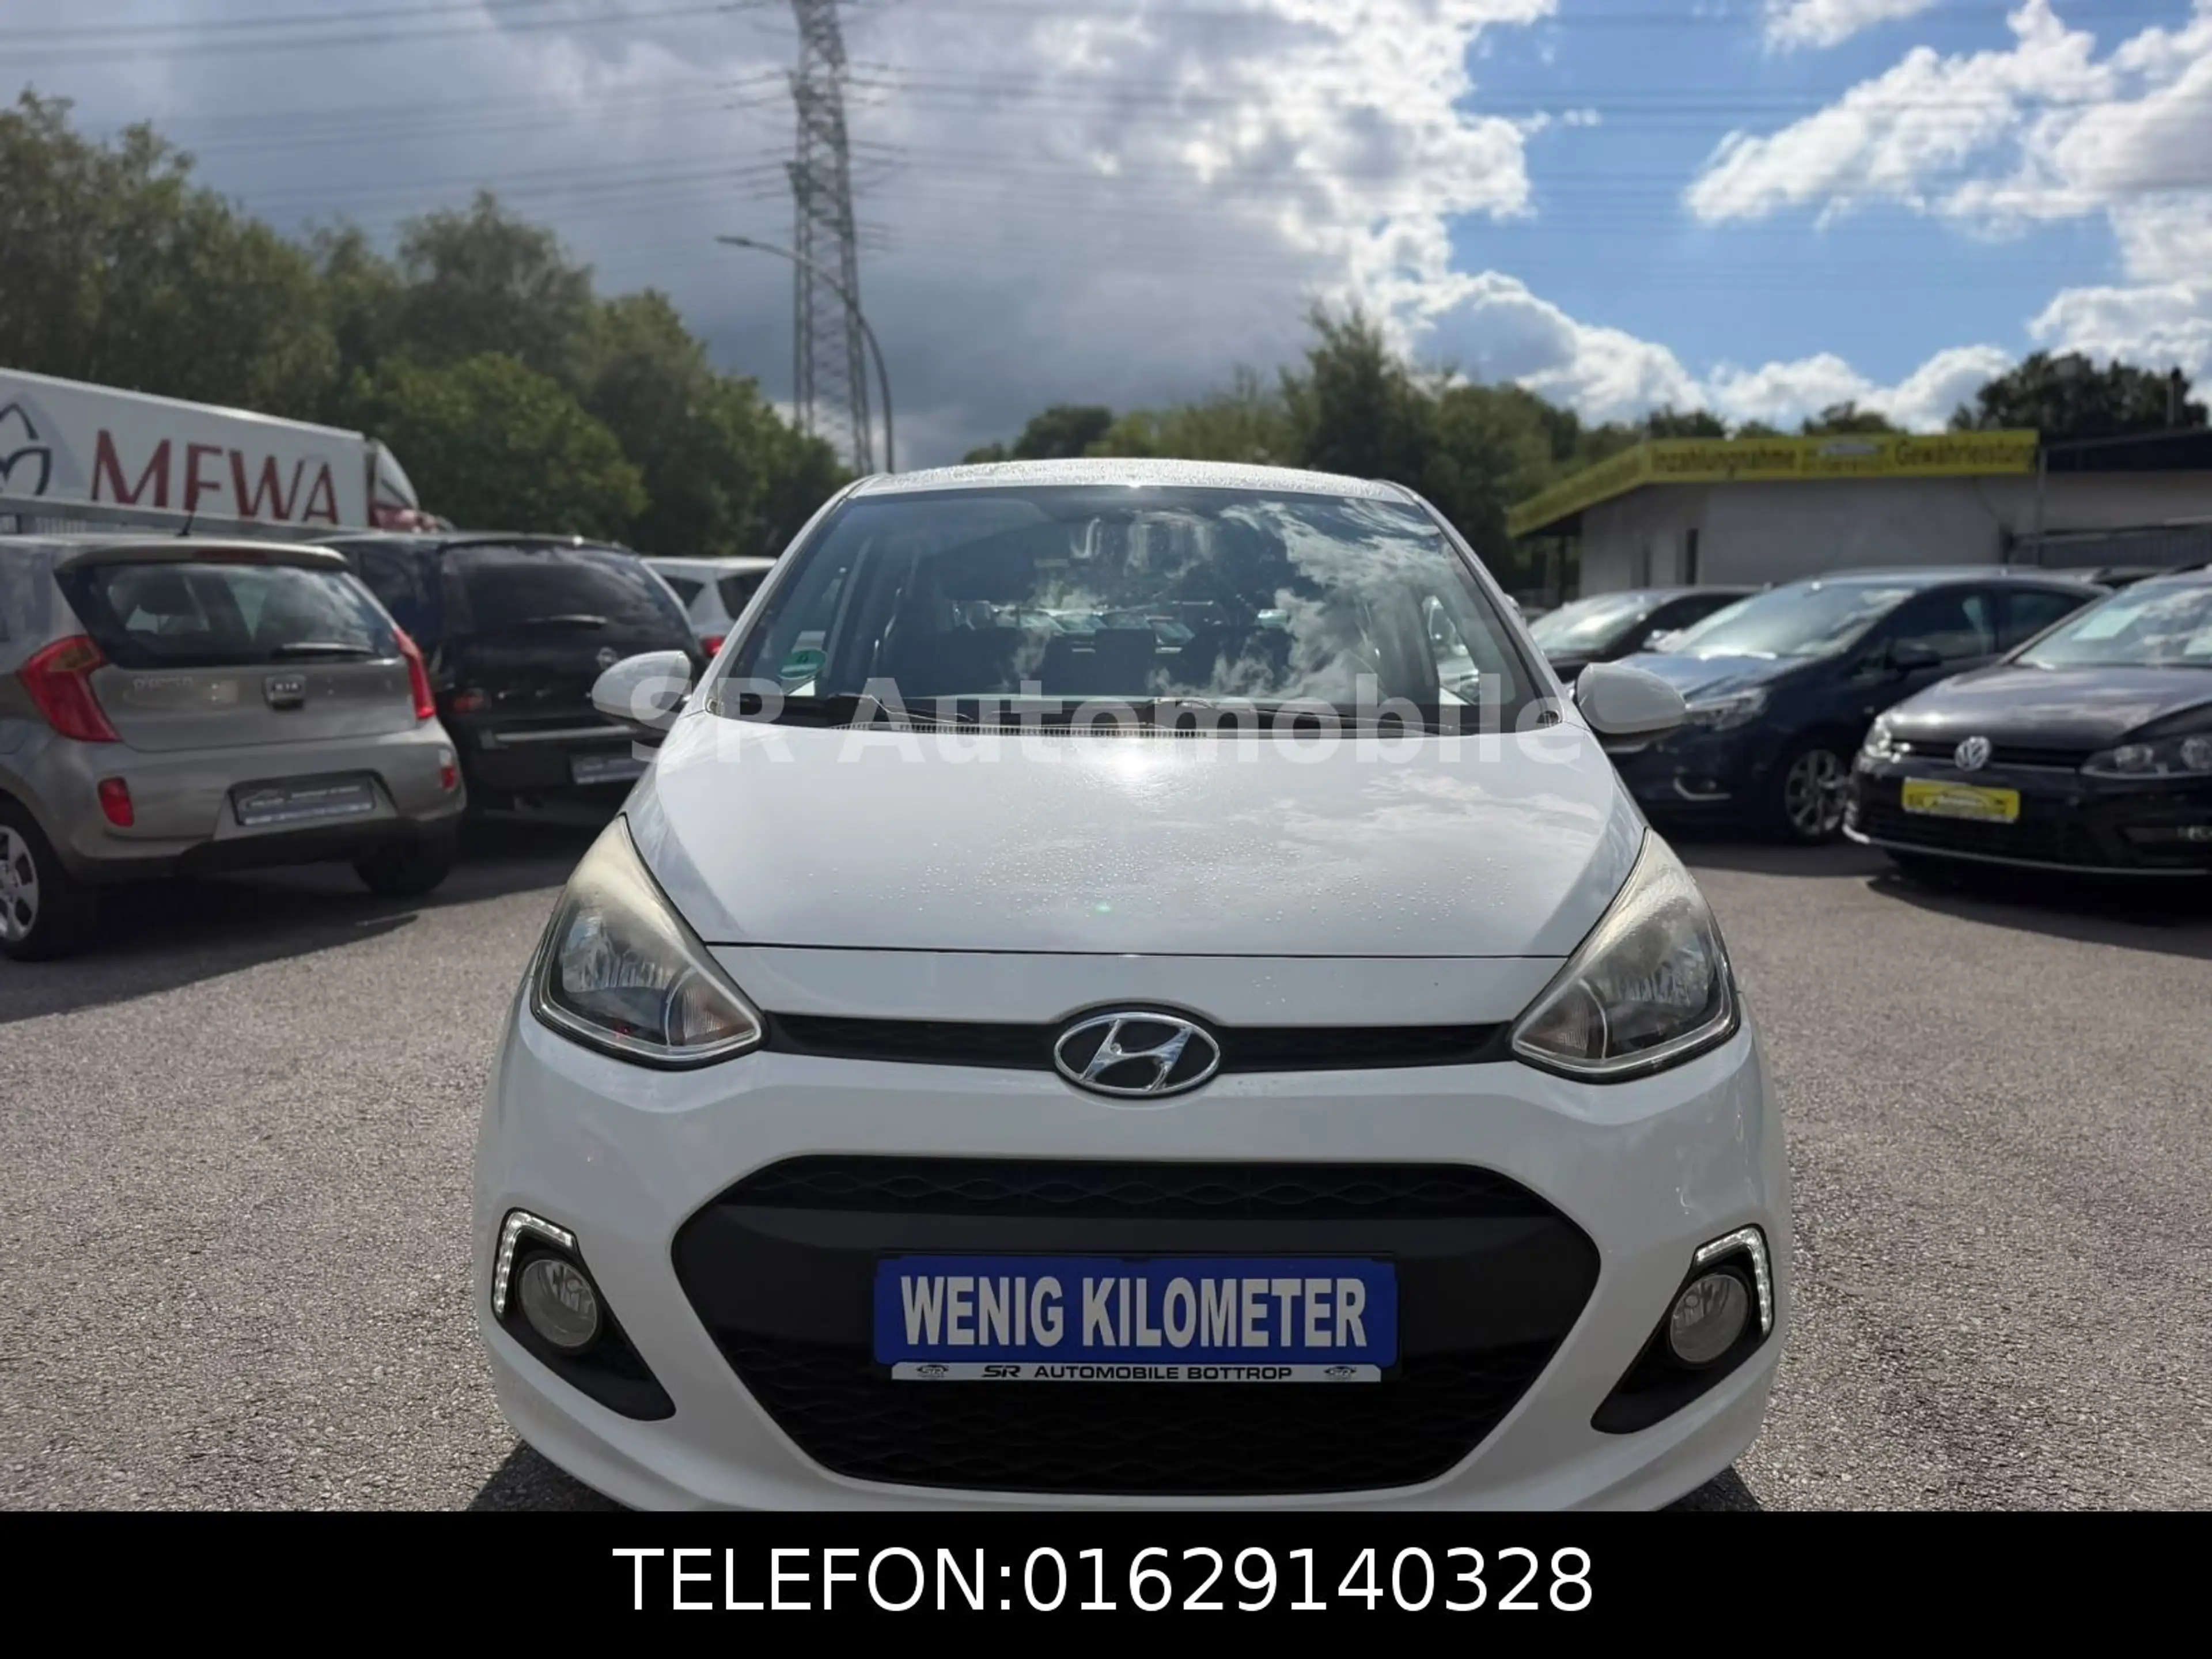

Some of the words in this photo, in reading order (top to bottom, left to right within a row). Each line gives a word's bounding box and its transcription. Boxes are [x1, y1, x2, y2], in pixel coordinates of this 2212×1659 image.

[900, 1276, 1064, 1347] WENIG
[1082, 1277, 1368, 1348] KILOMETER
[980, 1365, 1021, 1378] SR
[1034, 1366, 1179, 1380] AUTOMOBILE
[1187, 1367, 1293, 1380] BOTTROP
